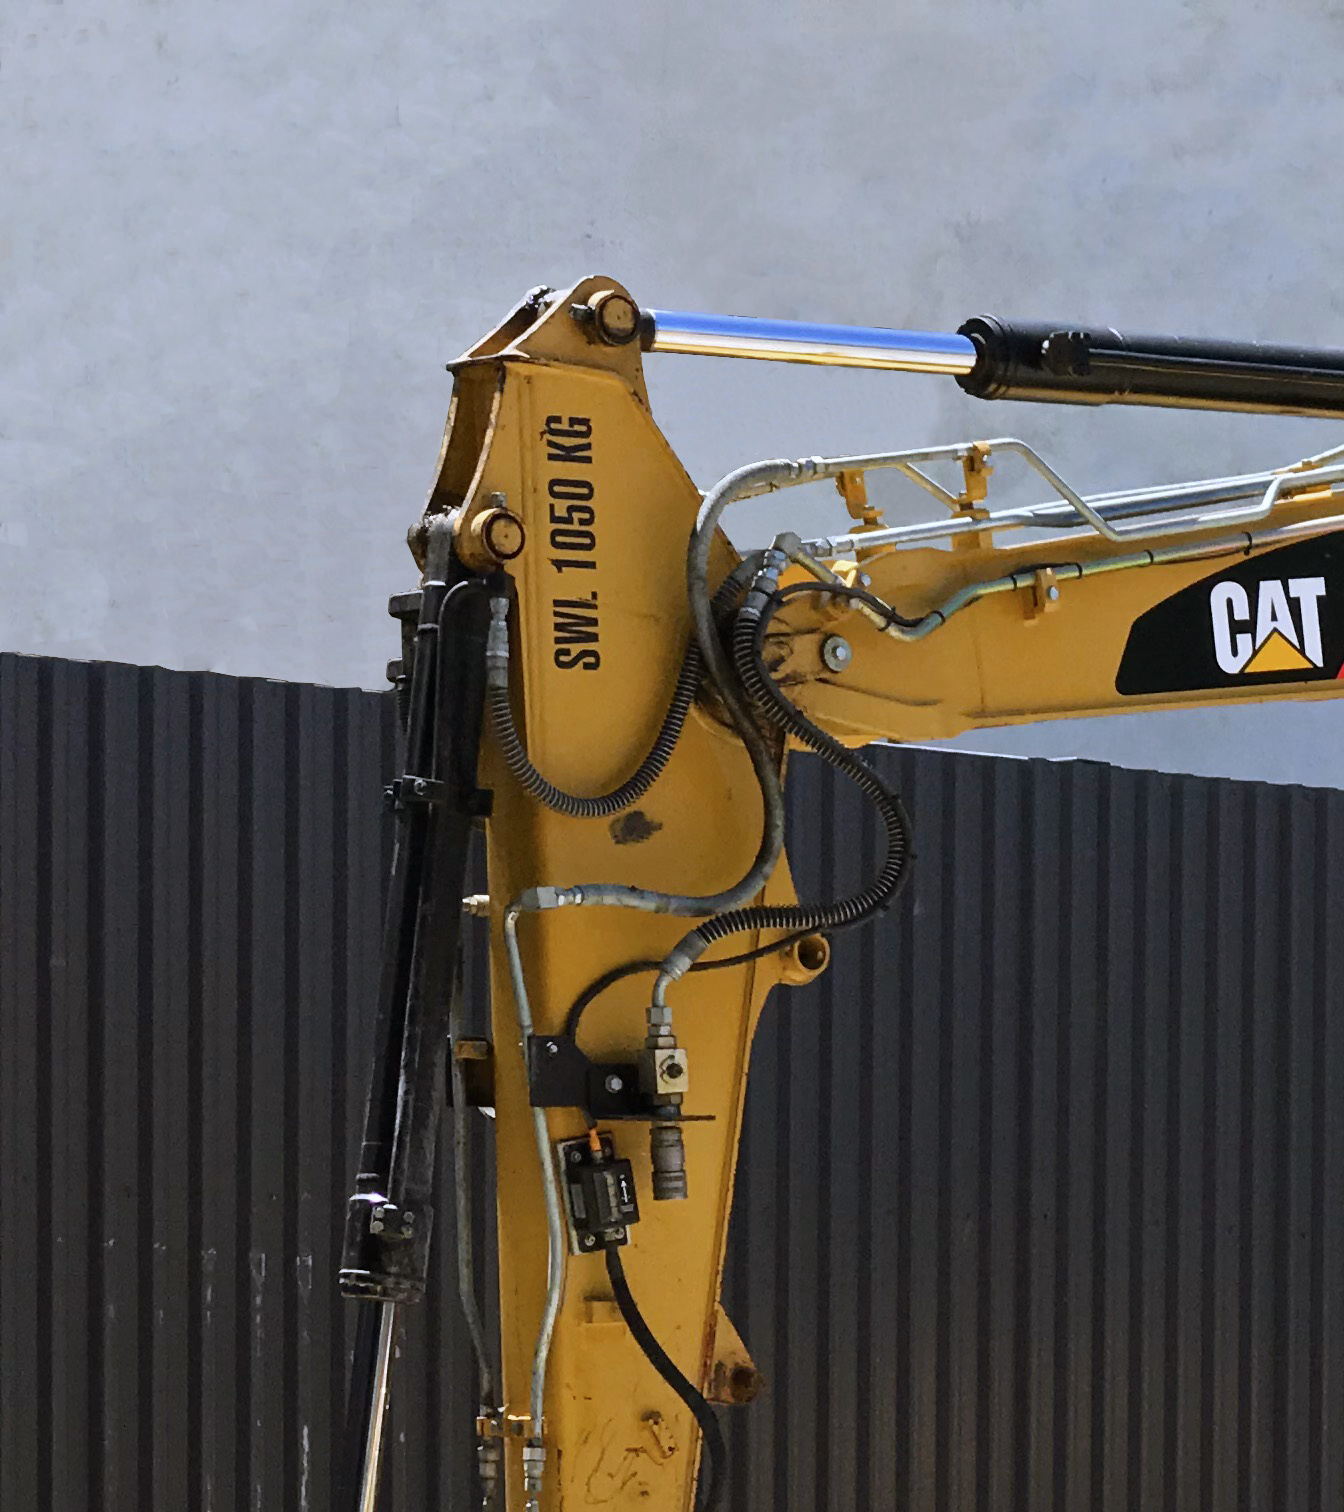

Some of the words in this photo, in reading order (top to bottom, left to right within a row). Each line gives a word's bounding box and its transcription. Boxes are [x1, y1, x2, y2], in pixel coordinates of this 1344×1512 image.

[544, 415, 593, 464] KG
[548, 478, 597, 573] 1050
[1210, 576, 1327, 675] CAT
